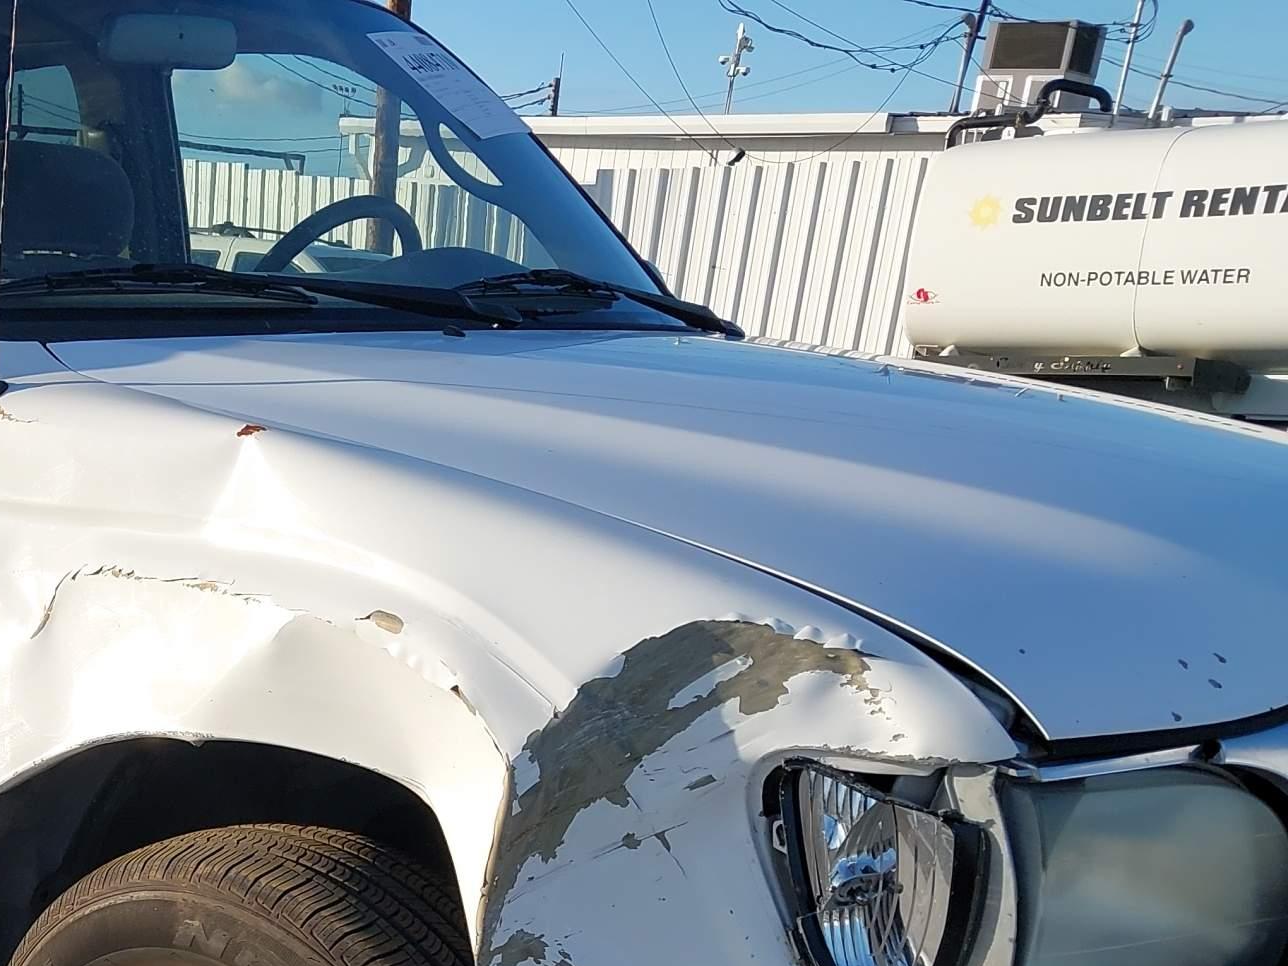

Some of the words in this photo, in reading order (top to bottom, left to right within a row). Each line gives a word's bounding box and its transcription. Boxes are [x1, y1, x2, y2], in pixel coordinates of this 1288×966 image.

[1011, 191, 1174, 224] SUNBELT
[1039, 270, 1175, 288] NON-POTABLE
[1179, 268, 1251, 286] WATER
